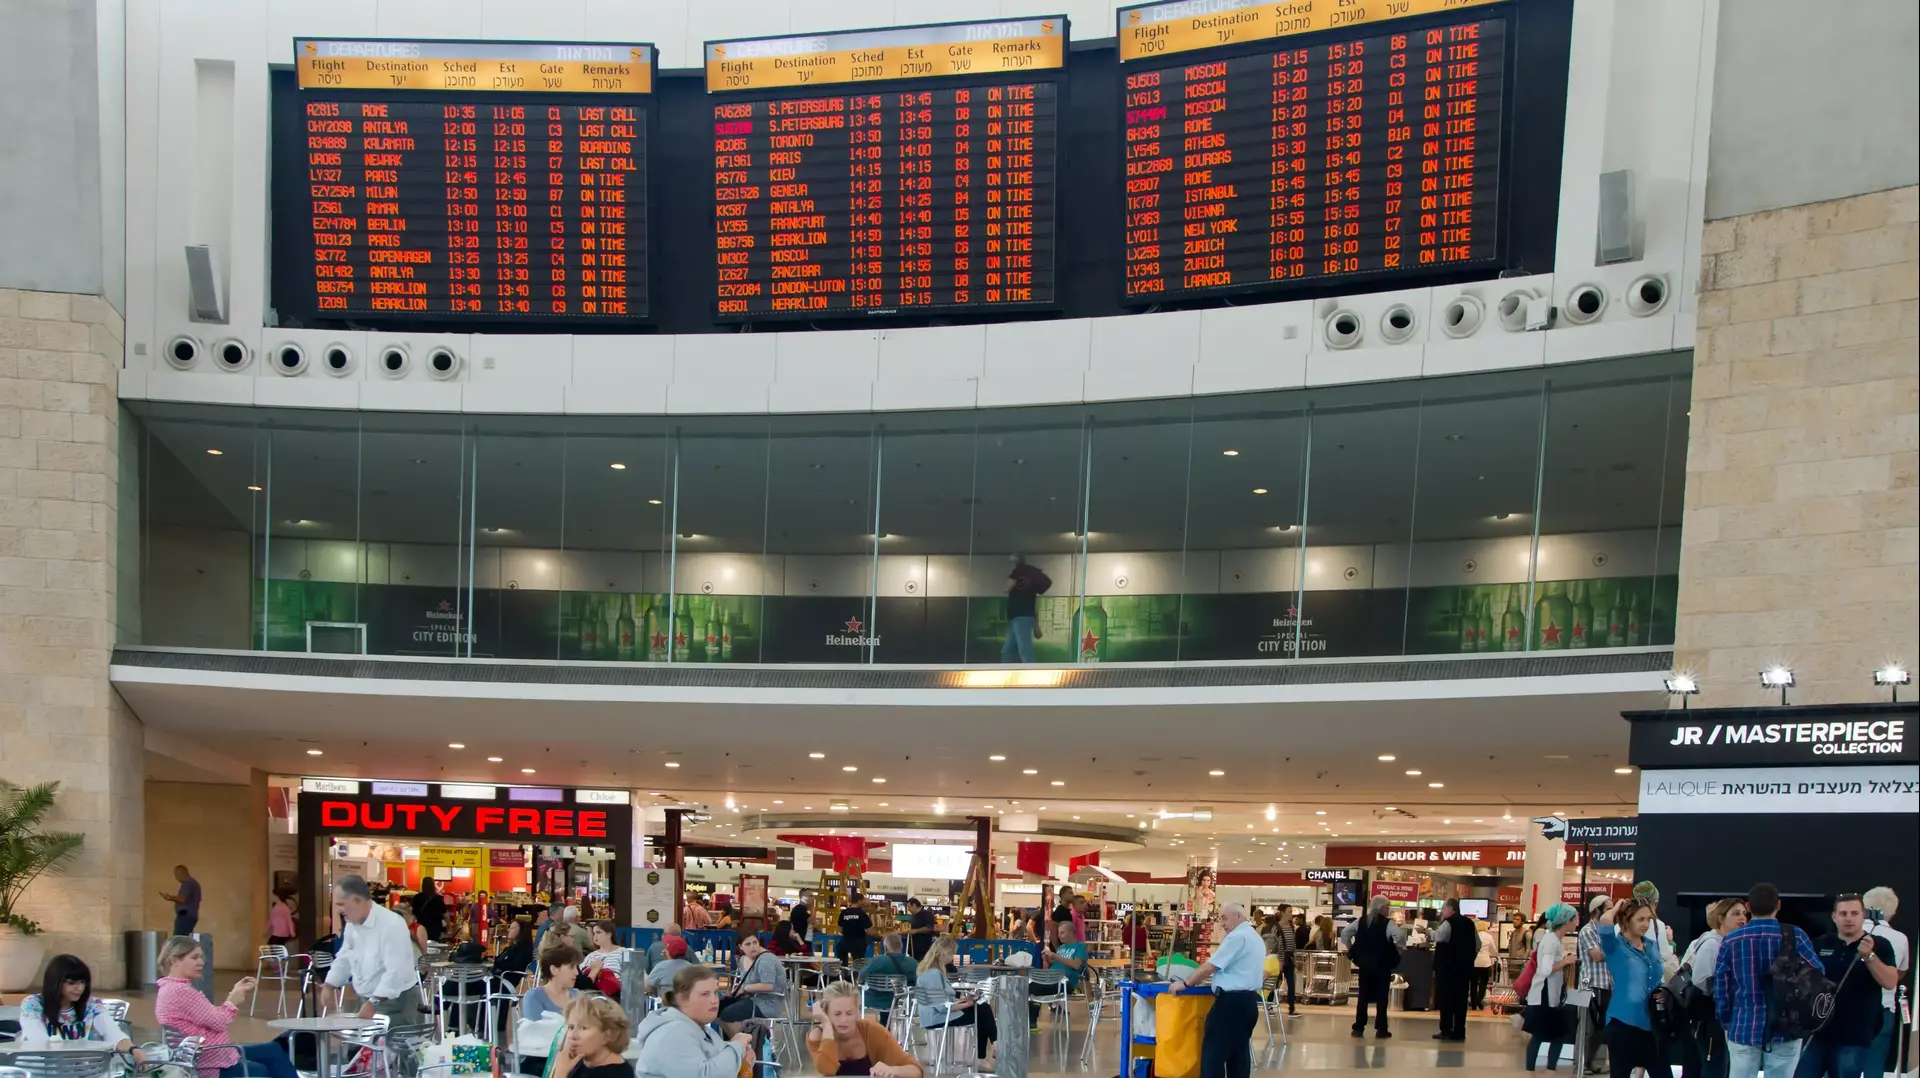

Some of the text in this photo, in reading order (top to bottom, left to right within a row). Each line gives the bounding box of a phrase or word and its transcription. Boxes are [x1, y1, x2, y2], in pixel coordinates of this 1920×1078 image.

[1134, 24, 1170, 39] Flight
[1192, 11, 1259, 30] Destination
[1275, 1, 1312, 17] Sched
[1139, 2, 1409, 53] שער מעודכן מתוכנן יעד טיסה
[965, 23, 1023, 40] המראות
[329, 44, 420, 57] DEPARTURES
[556, 47, 612, 61] המראות
[738, 38, 827, 57] DEPARTURES
[721, 40, 1041, 74] Flight Destination Sched Est Gate Remarks
[312, 60, 630, 74] Flight Destination Sched Est Gate Remarks
[726, 55, 1033, 86] הערות שער מעודכן מתוכנן יעד טיסה
[318, 73, 622, 90] הערות שער מעודכן מתוכנן יעד טיסה
[1128, 98, 1476, 158] LY545 ATHENS 15:30 15:30 D4 ON TIME
[716, 137, 1032, 168] AF1961 PARIS 14:00 14:00 D4 ON TIME
[716, 154, 1032, 184] PS776 KIEV 14:15 14:15 B3 ON TIME
[310, 169, 624, 186] LY327 PARIS 12:45 12:45 D2 ON TIME
[1128, 154, 1474, 209] TK787 ISTANBUL 15:45 15:45 C9 ON TIME
[312, 184, 624, 202] EZY2564 MILAN 12:50 12:50 B7 ON TIME
[717, 205, 1032, 233] LY355 FRANKFURT 14:40 14:40 D5 ON TIME
[1128, 209, 1472, 260] LX255 ZURICH 16:00 16:00 C7 ON TIME
[315, 249, 626, 266] SK772 COPENHAGEN 13:25 13:25 C4 ON TIME
[426, 611, 463, 619] Heineken
[1273, 618, 1313, 627] Heineen
[412, 631, 478, 644] CITY EDITION
[825, 635, 881, 646] Heineken
[1258, 640, 1327, 652] CITY EDTION
[1670, 720, 1905, 746] JR / MASTERPIECE
[1812, 742, 1903, 755] COLLECTION
[315, 782, 347, 792] Marlboro
[1647, 781, 1717, 796] LALIQUE
[1721, 781, 1791, 796] בהשראת
[1798, 781, 1862, 795] מעצבים
[321, 801, 607, 837] DUTY FREE
[1571, 825, 1602, 837] בצלאל
[1375, 851, 1481, 862] LIQUOR & WINE
[1592, 852, 1635, 861] בדיוטי פרי
[1307, 870, 1347, 880] CHANEL
[1121, 903, 1134, 911] Dio
